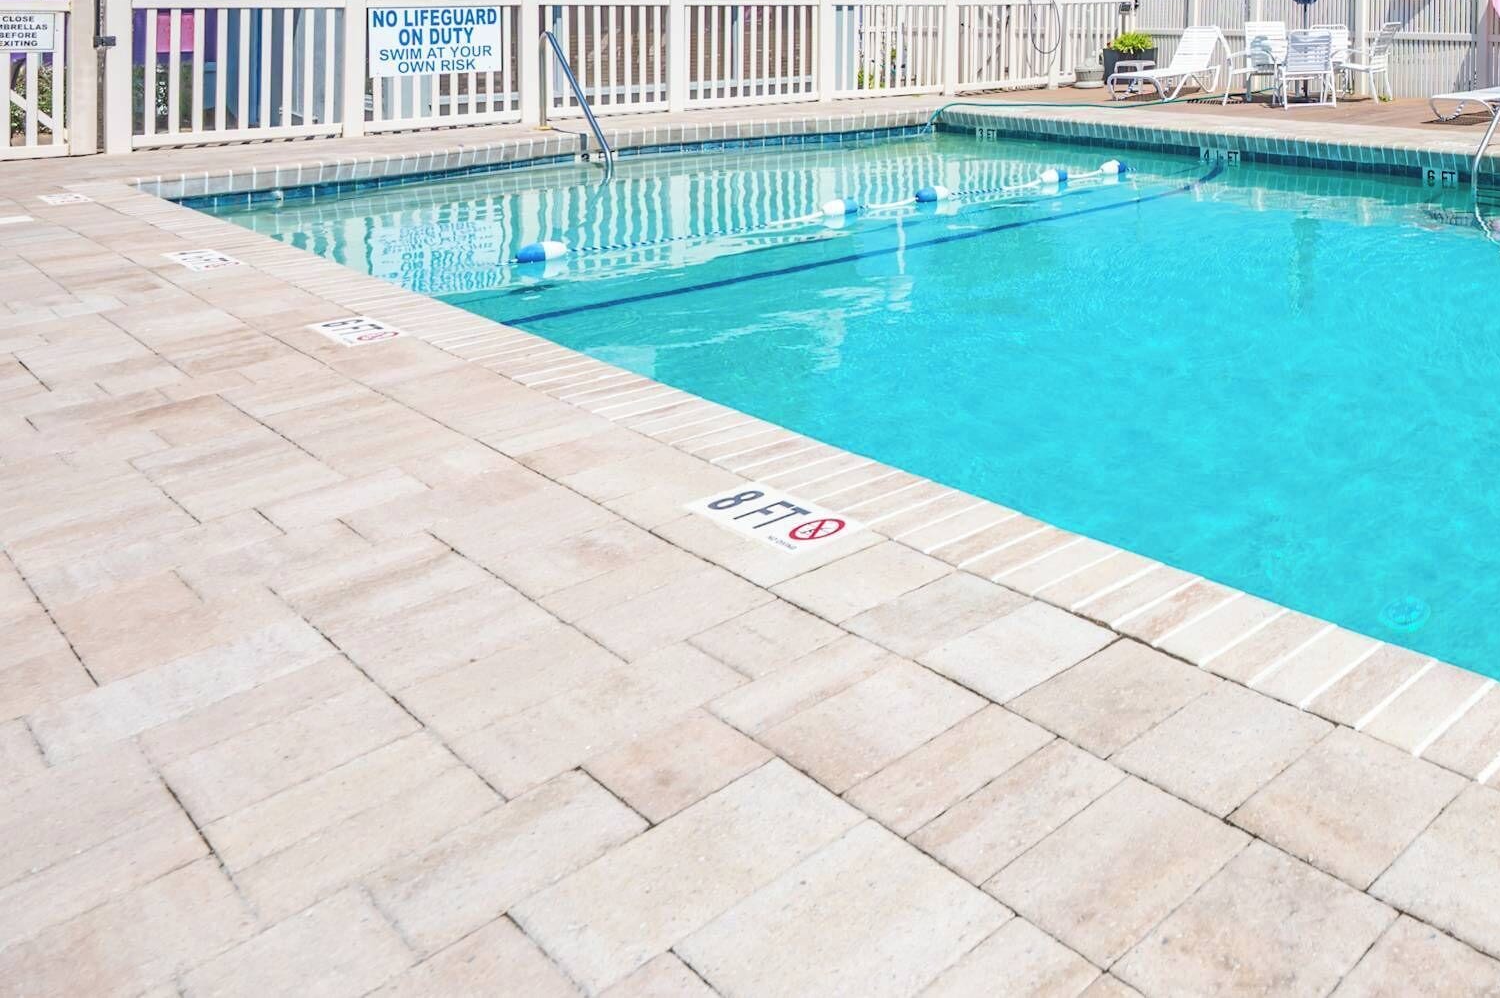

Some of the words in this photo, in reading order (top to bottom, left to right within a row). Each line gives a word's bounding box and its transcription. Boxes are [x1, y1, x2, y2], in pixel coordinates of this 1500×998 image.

[2, 15, 34, 23] CLOSE
[373, 10, 397, 27] NO
[405, 8, 497, 26] LIFEGUARD
[399, 29, 422, 46] ON
[430, 27, 474, 44] DUTY
[379, 48, 422, 61] SWIM
[427, 47, 445, 59] AT
[450, 45, 492, 57] YOUR
[398, 60, 435, 73] OWN
[441, 58, 476, 71] RISK
[707, 490, 765, 510] 8
[733, 500, 812, 529] FT
